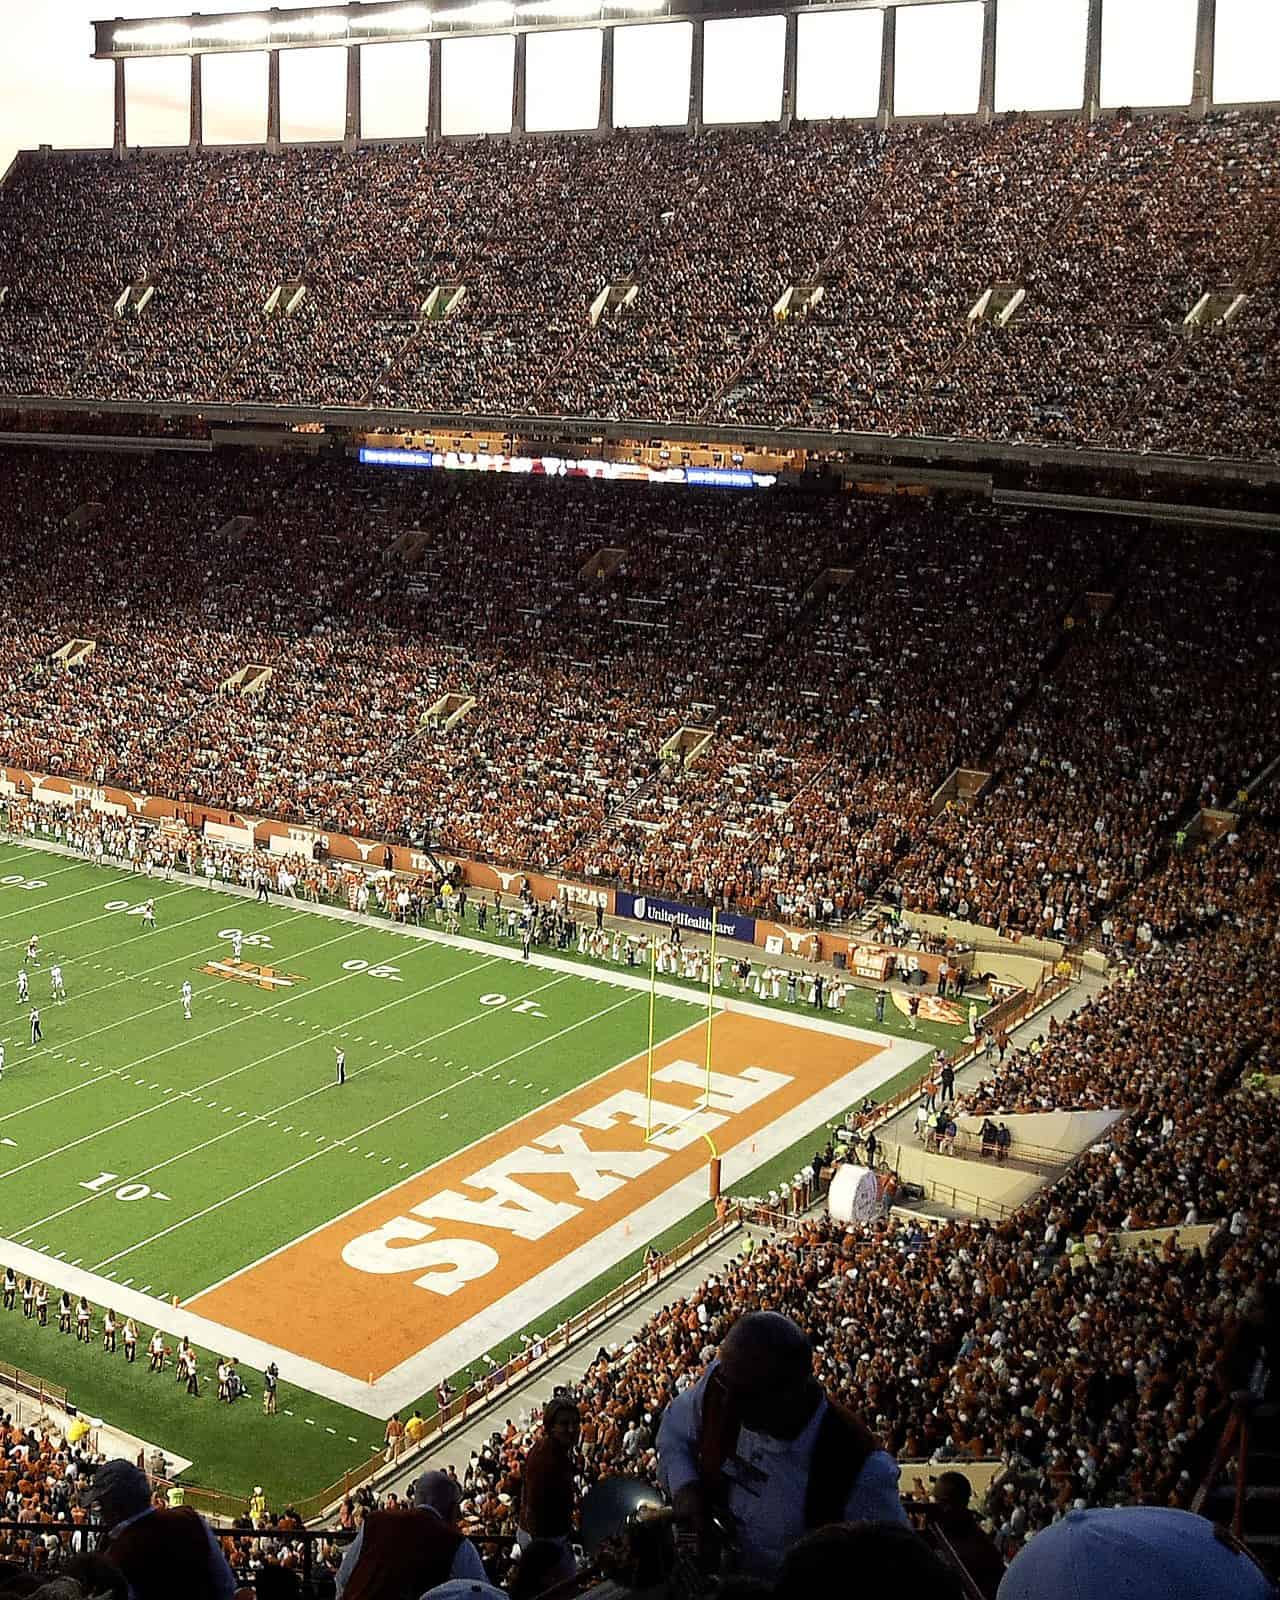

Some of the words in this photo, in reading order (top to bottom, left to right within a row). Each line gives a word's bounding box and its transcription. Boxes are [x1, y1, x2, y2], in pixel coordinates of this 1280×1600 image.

[557, 883, 608, 909] TEXAS
[647, 906, 737, 936] UnitedHealthare
[77, 1171, 152, 1202] 10
[341, 1059, 796, 1297] TEXAS
